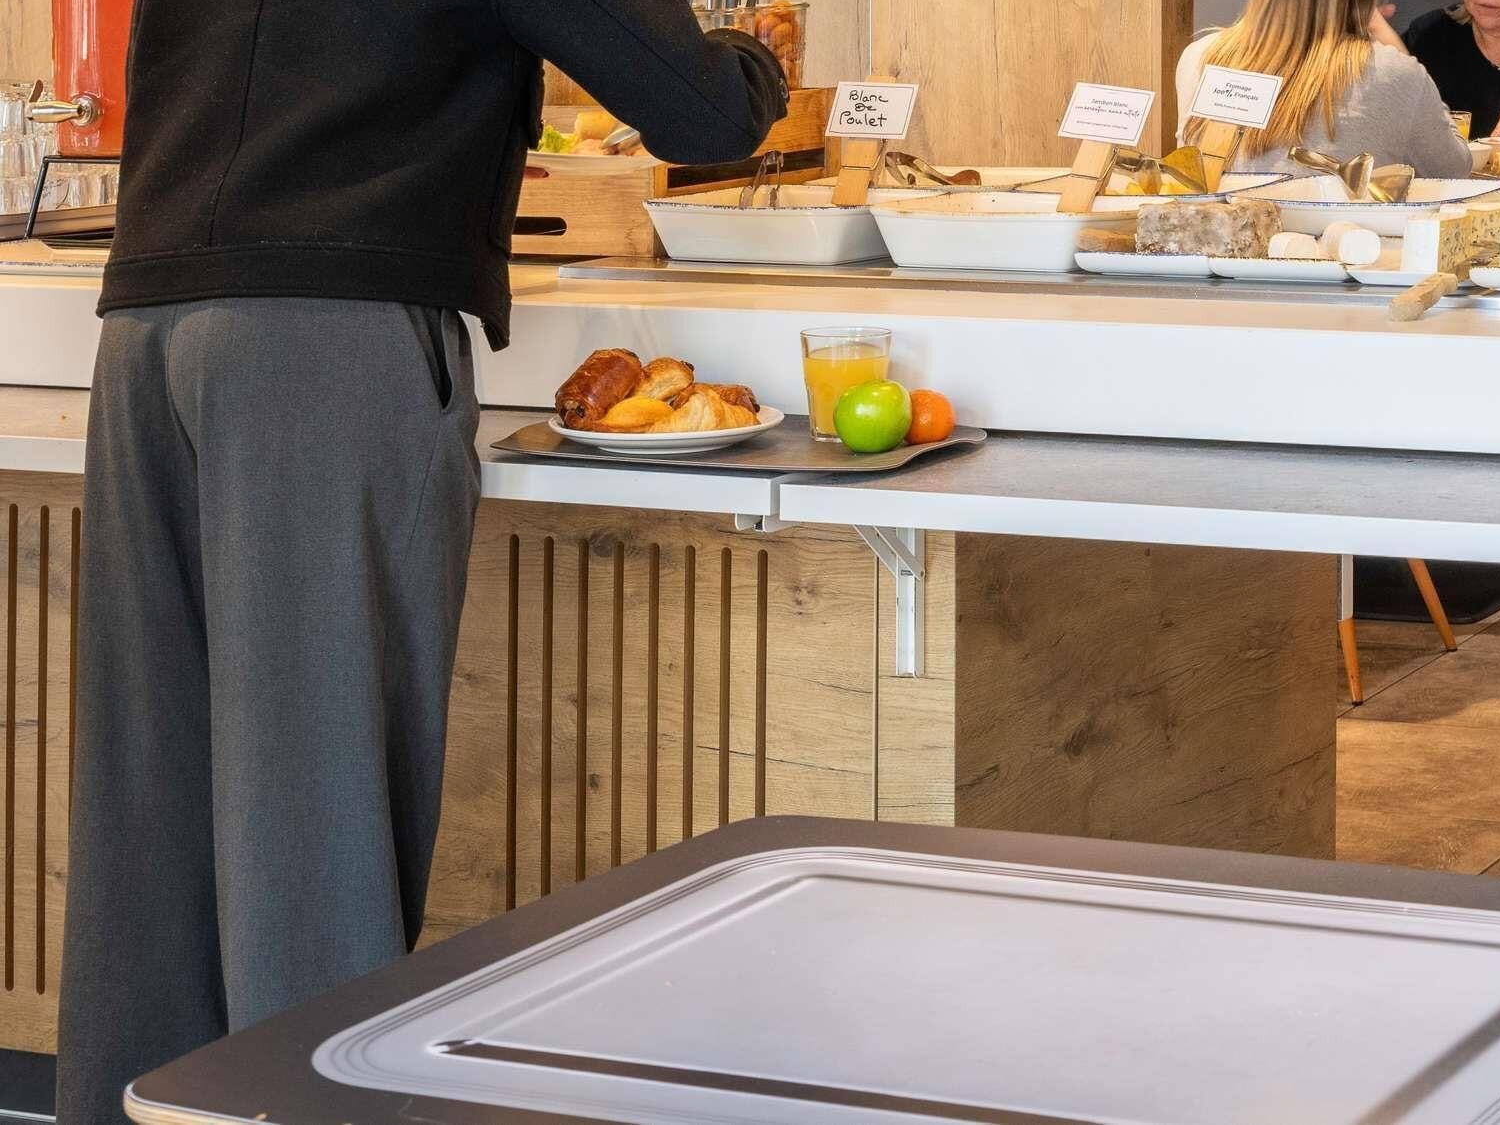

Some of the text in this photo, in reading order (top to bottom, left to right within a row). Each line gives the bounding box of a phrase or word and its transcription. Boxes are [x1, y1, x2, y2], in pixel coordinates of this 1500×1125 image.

[1226, 82, 1252, 92] Fromage
[849, 90, 889, 103] Blanc
[1234, 91, 1259, 101] Français
[839, 110, 887, 127] Poulet
